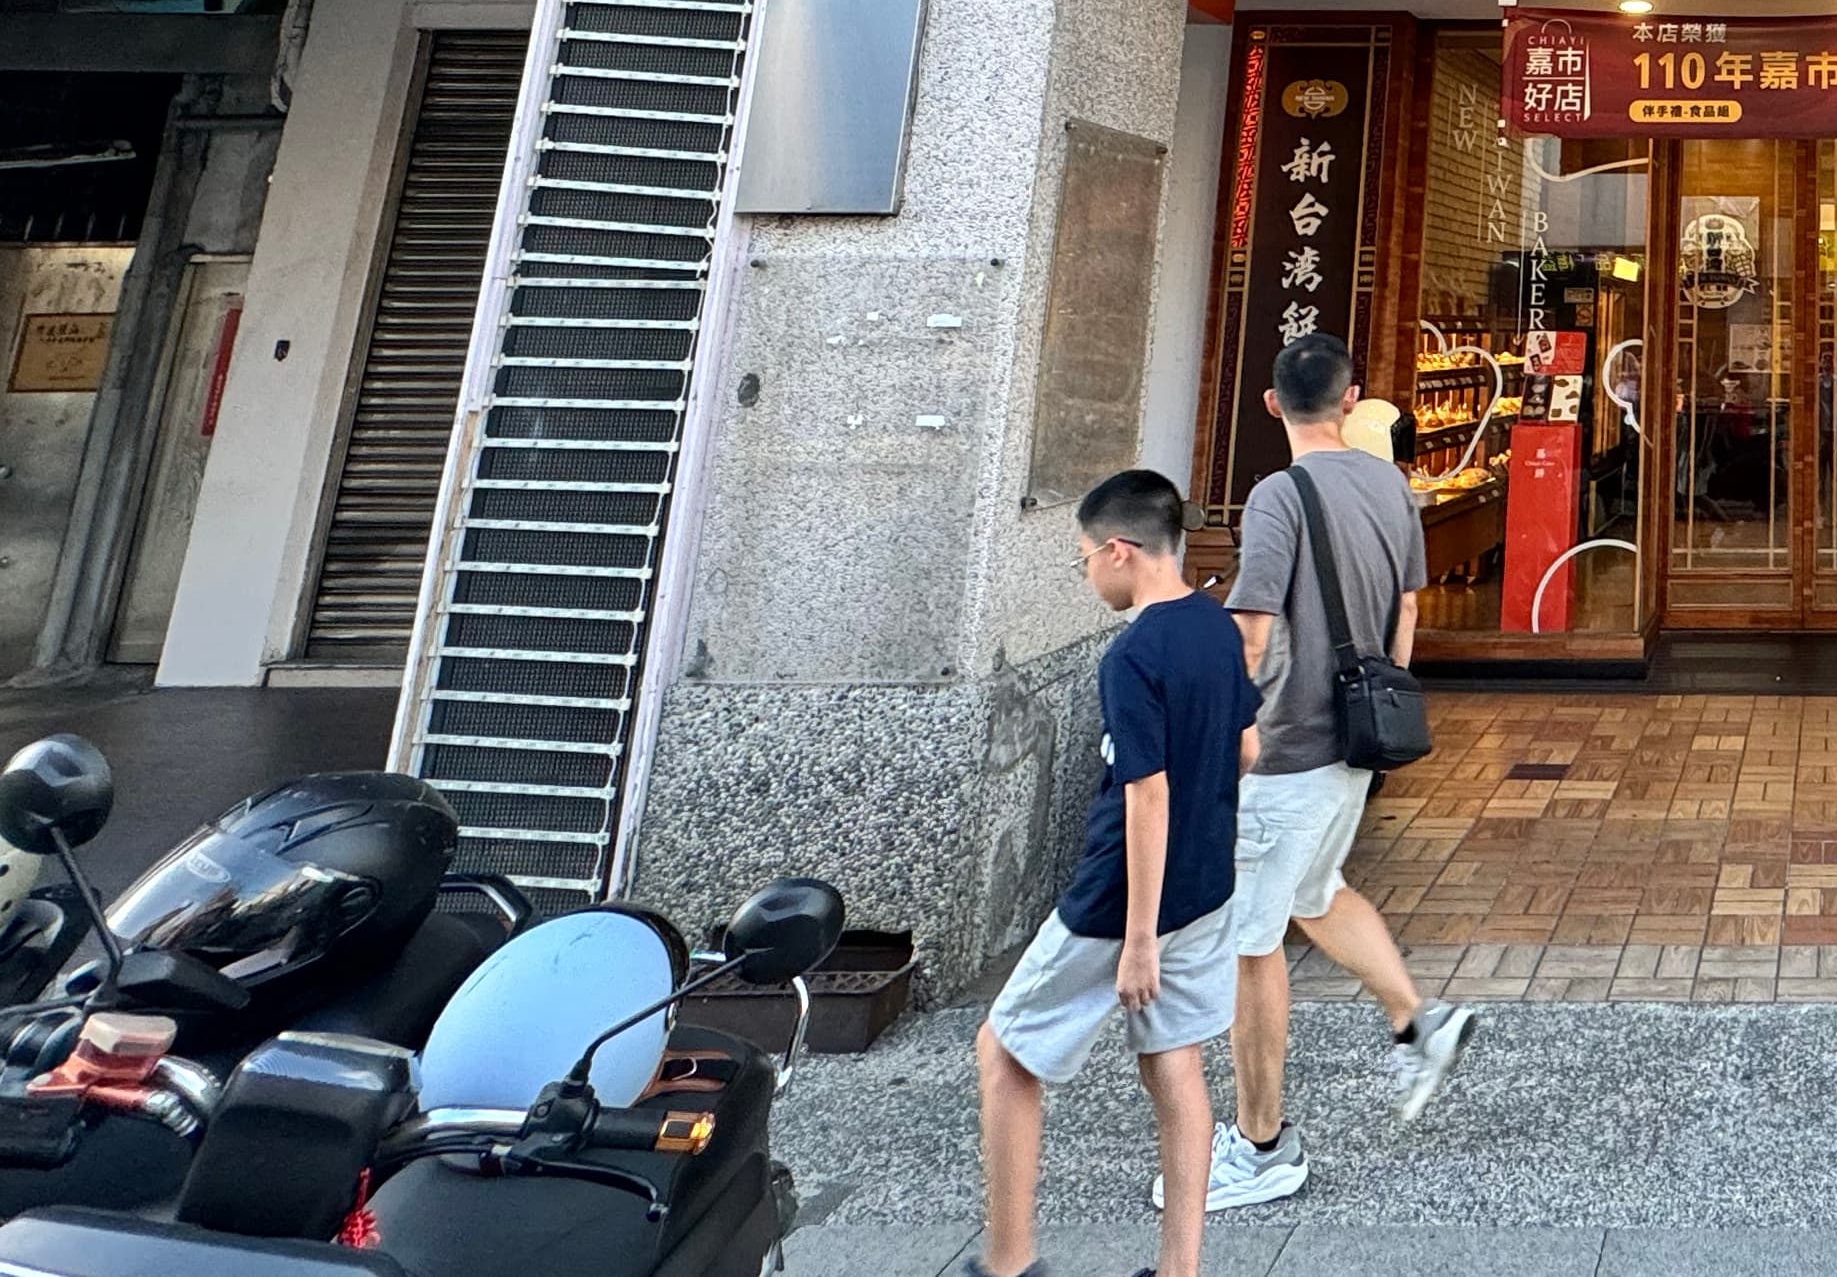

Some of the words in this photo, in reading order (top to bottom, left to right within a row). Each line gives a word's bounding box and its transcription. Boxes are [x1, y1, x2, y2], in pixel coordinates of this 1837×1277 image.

[1527, 35, 1585, 46] CHIAYI
[1632, 23, 1728, 43] 本店榮獲
[1525, 47, 1586, 76] 嘉市
[1523, 82, 1584, 112] 好店
[1453, 84, 1479, 154] NEW
[1523, 113, 1583, 122] SELECT
